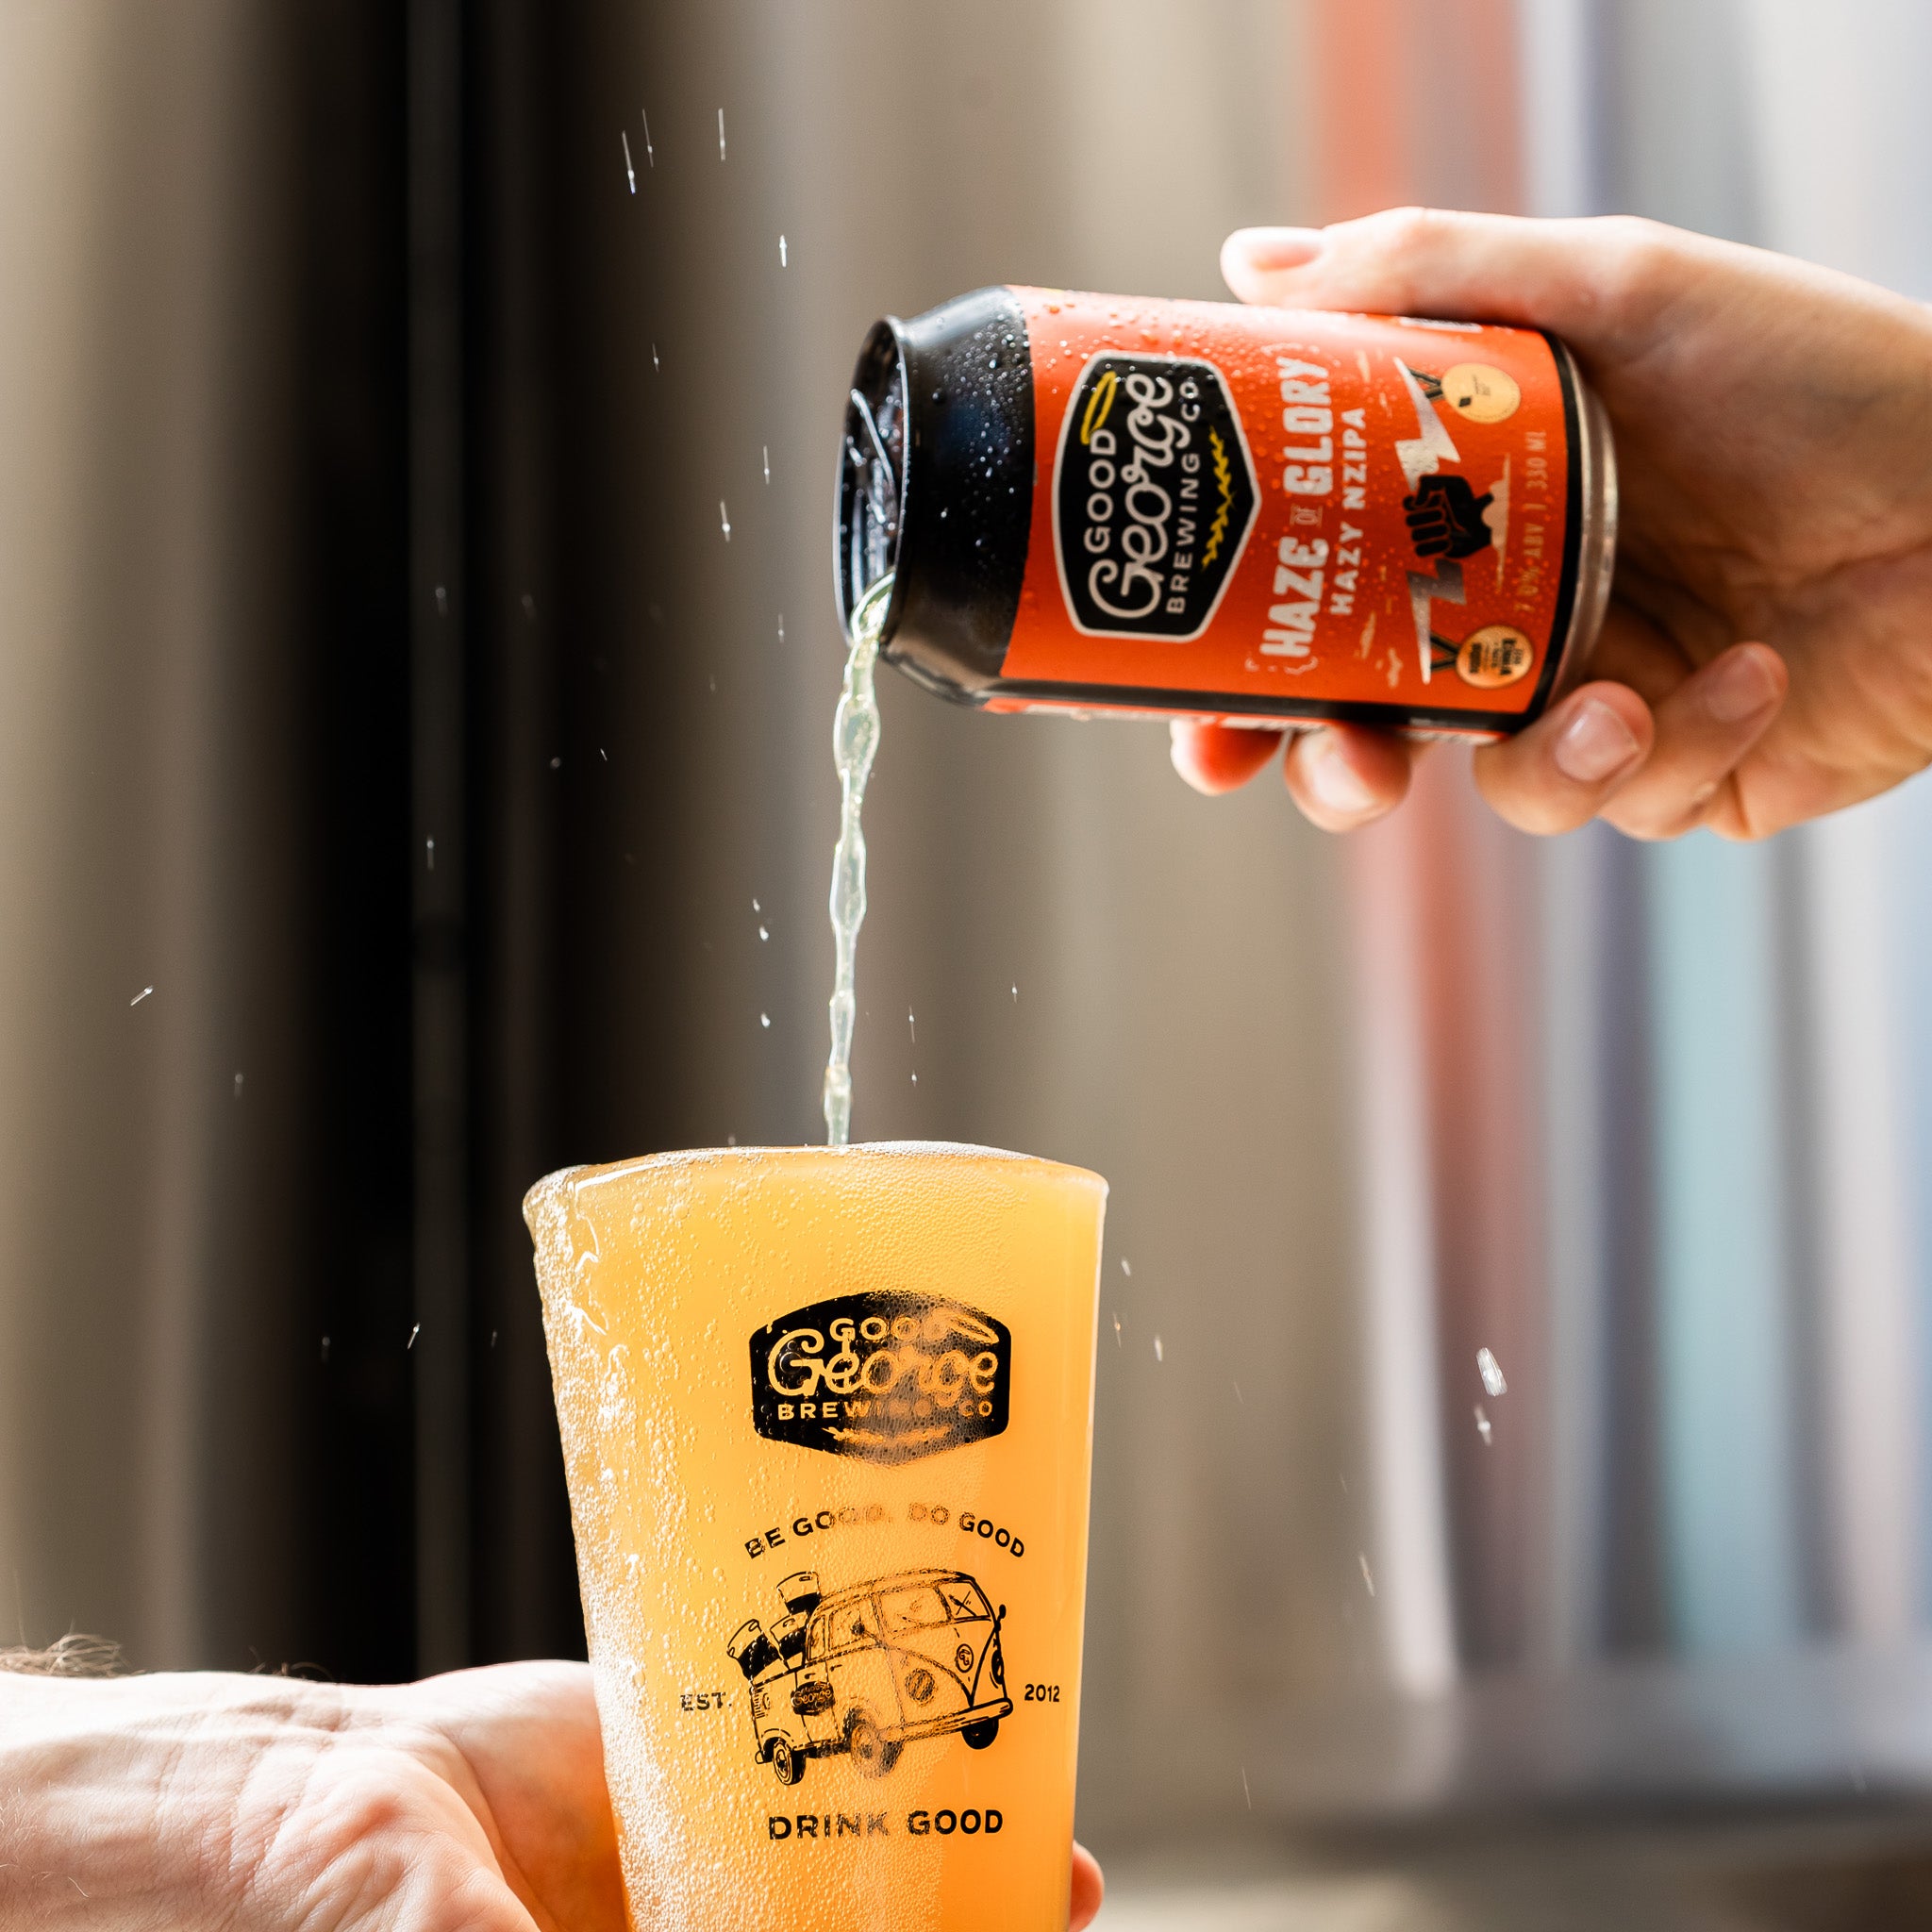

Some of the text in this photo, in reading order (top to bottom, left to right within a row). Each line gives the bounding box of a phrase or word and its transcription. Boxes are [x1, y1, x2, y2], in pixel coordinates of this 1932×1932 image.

[1275, 356, 1335, 495] GLORY
[1524, 456, 1548, 491] 330
[1084, 428, 1117, 554] GOOD
[1088, 374, 1191, 619] George
[1166, 380, 1201, 614] BREWING CO
[1328, 408, 1367, 616] HAZY NZIPA
[1259, 536, 1329, 658] HAZE
[777, 1401, 932, 1421] BREW
[744, 1526, 787, 1559] BE
[908, 1502, 950, 1526] DO
[958, 1511, 1026, 1558] GOOD
[680, 1683, 1061, 1711] EST. 2012
[768, 1808, 1004, 1840] DRINK GOOD
